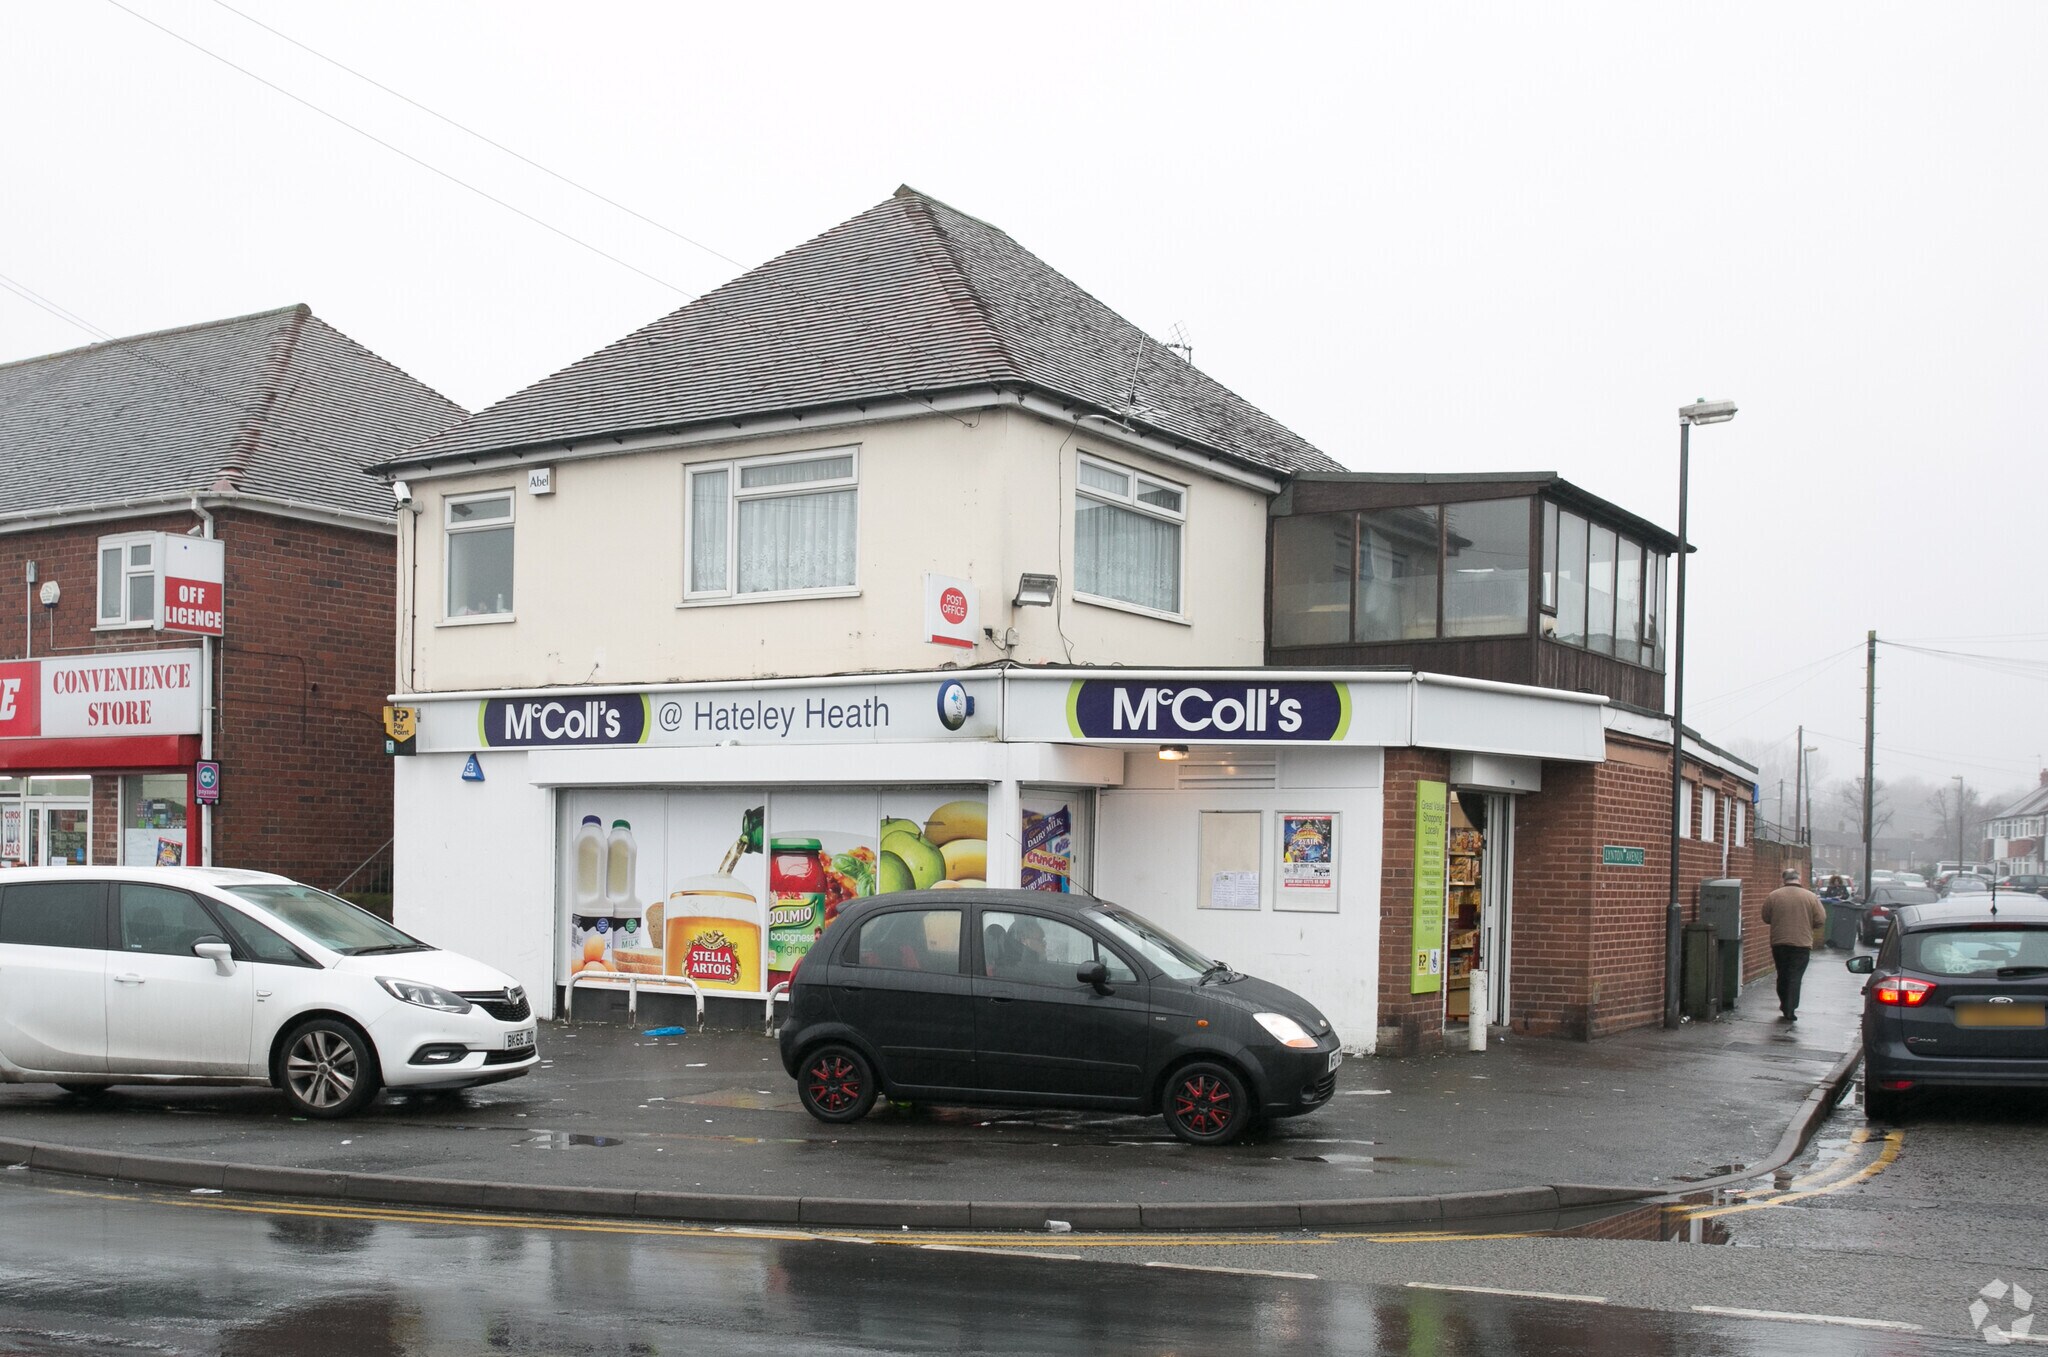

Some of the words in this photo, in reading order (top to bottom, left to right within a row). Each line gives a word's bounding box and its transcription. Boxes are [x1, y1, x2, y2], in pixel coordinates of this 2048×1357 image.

[530, 475, 549, 487] Abel
[179, 585, 205, 604] OFF
[946, 594, 963, 605] POST
[942, 604, 965, 617] OFFICE
[165, 607, 222, 628] LICENCE
[53, 663, 191, 695] CONVENIENCE
[88, 700, 152, 726] STORE
[1112, 687, 1303, 733] McColl's
[505, 701, 621, 740] McColl's
[659, 701, 683, 732] @
[694, 700, 796, 738] Hateley
[806, 695, 889, 729] Heath
[394, 723, 404, 731] Pay
[1028, 830, 1046, 847] DAIRY
[1046, 817, 1063, 831] MILK
[621, 939, 640, 949] MILK
[776, 944, 809, 956] original
[692, 951, 732, 963] STELLA
[692, 963, 732, 976] ARTOIS
